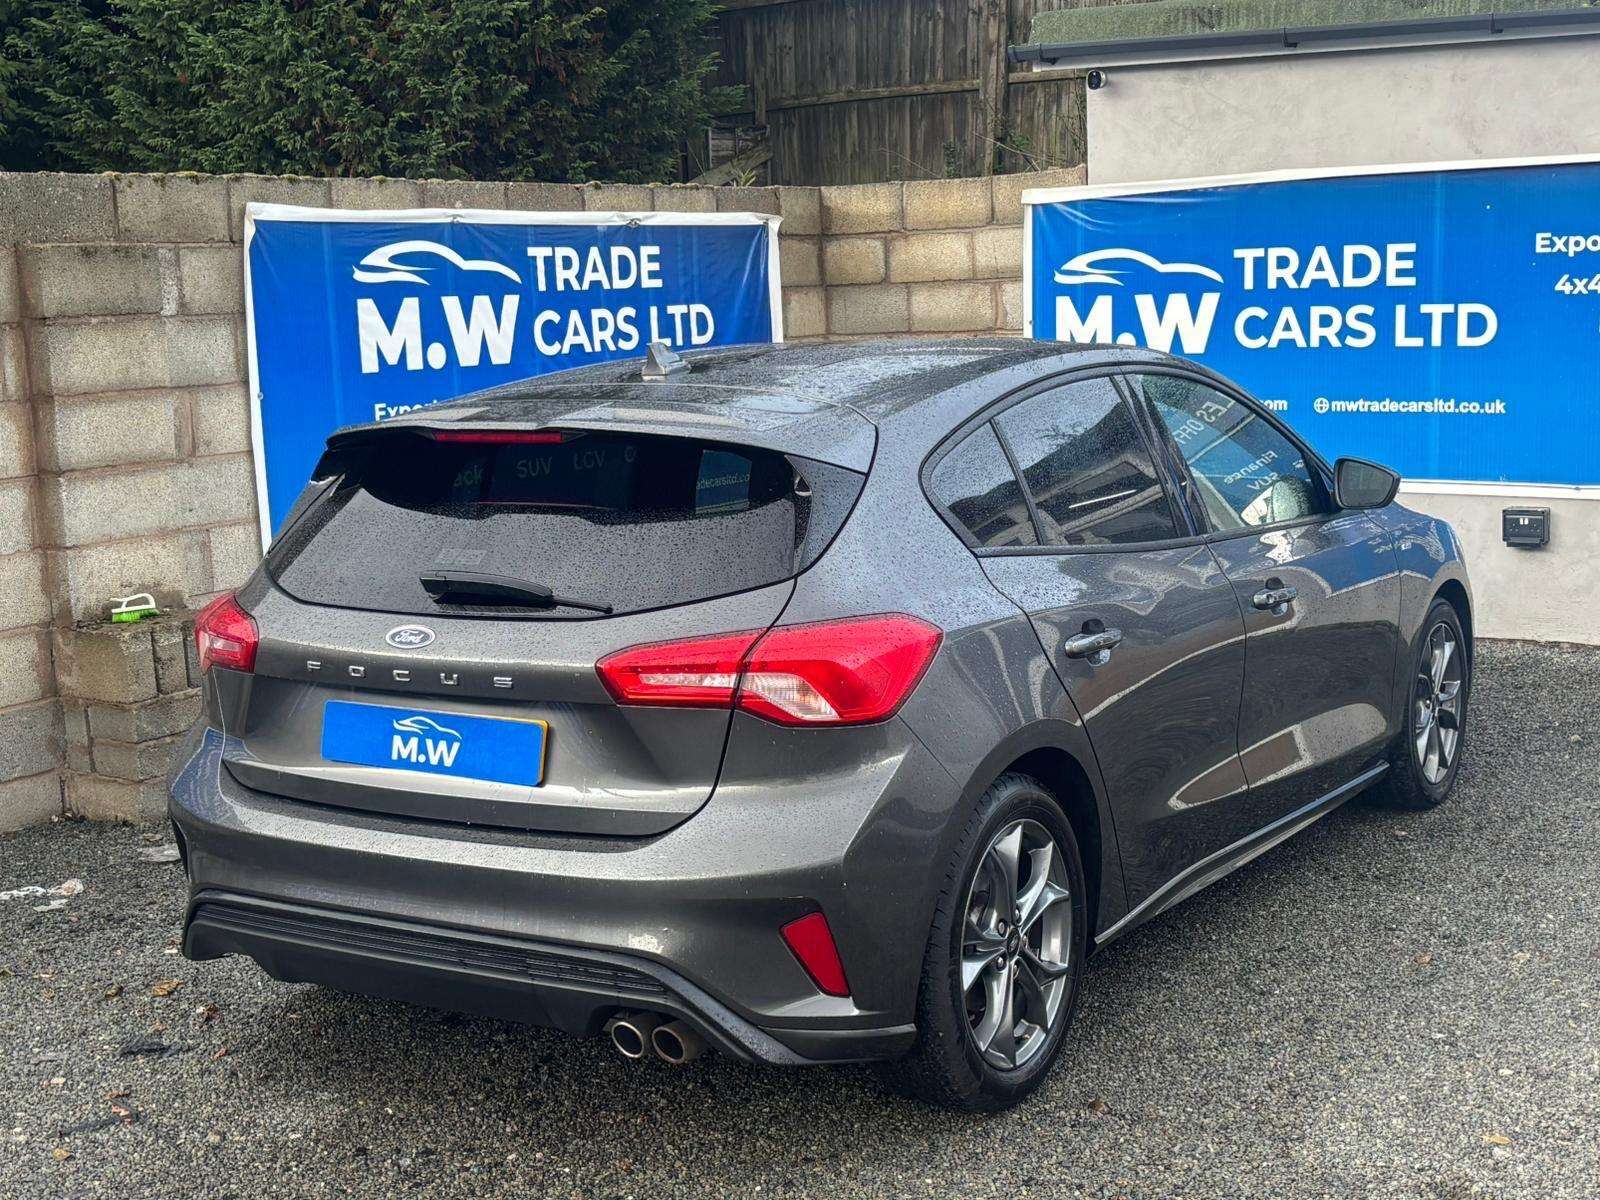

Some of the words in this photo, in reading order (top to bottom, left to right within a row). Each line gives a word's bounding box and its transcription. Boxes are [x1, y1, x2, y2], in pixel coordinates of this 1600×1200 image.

[1233, 243, 1417, 290] TRADE
[1535, 232, 1600, 257] Expo
[526, 245, 663, 292] TRADE
[356, 294, 520, 374] M.W
[533, 306, 640, 357] CARS
[649, 303, 715, 346] LTD
[1055, 292, 1221, 354] M.W
[1234, 304, 1377, 349] CARS
[1394, 303, 1498, 348] LTD
[1259, 399, 1288, 411] om
[1331, 398, 1506, 414] mwtradecarsltd.co.uk
[516, 456, 553, 478] SUV
[306, 660, 513, 689] FOCUS
[391, 734, 461, 768] M.W
